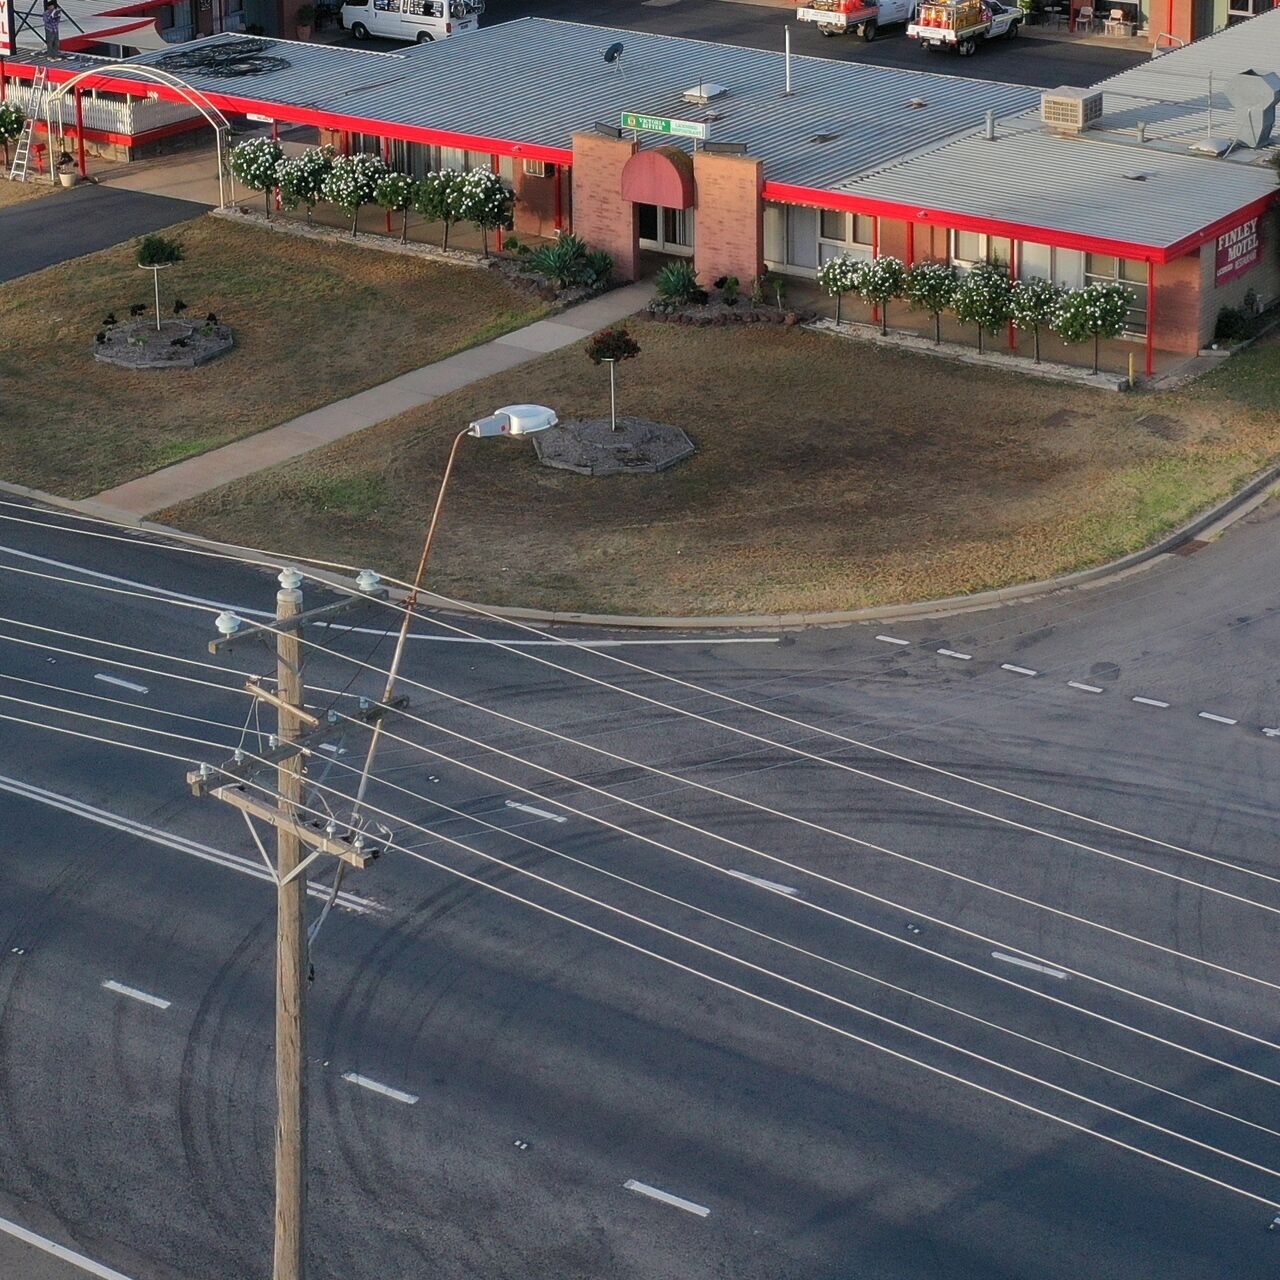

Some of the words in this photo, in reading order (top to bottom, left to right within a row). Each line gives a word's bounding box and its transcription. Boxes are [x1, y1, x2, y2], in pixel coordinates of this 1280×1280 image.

[638, 117, 666, 127] VICTORIA
[642, 122, 663, 131] BITTER
[1218, 217, 1258, 251] FINLEY
[1228, 233, 1259, 262] MOTEL
